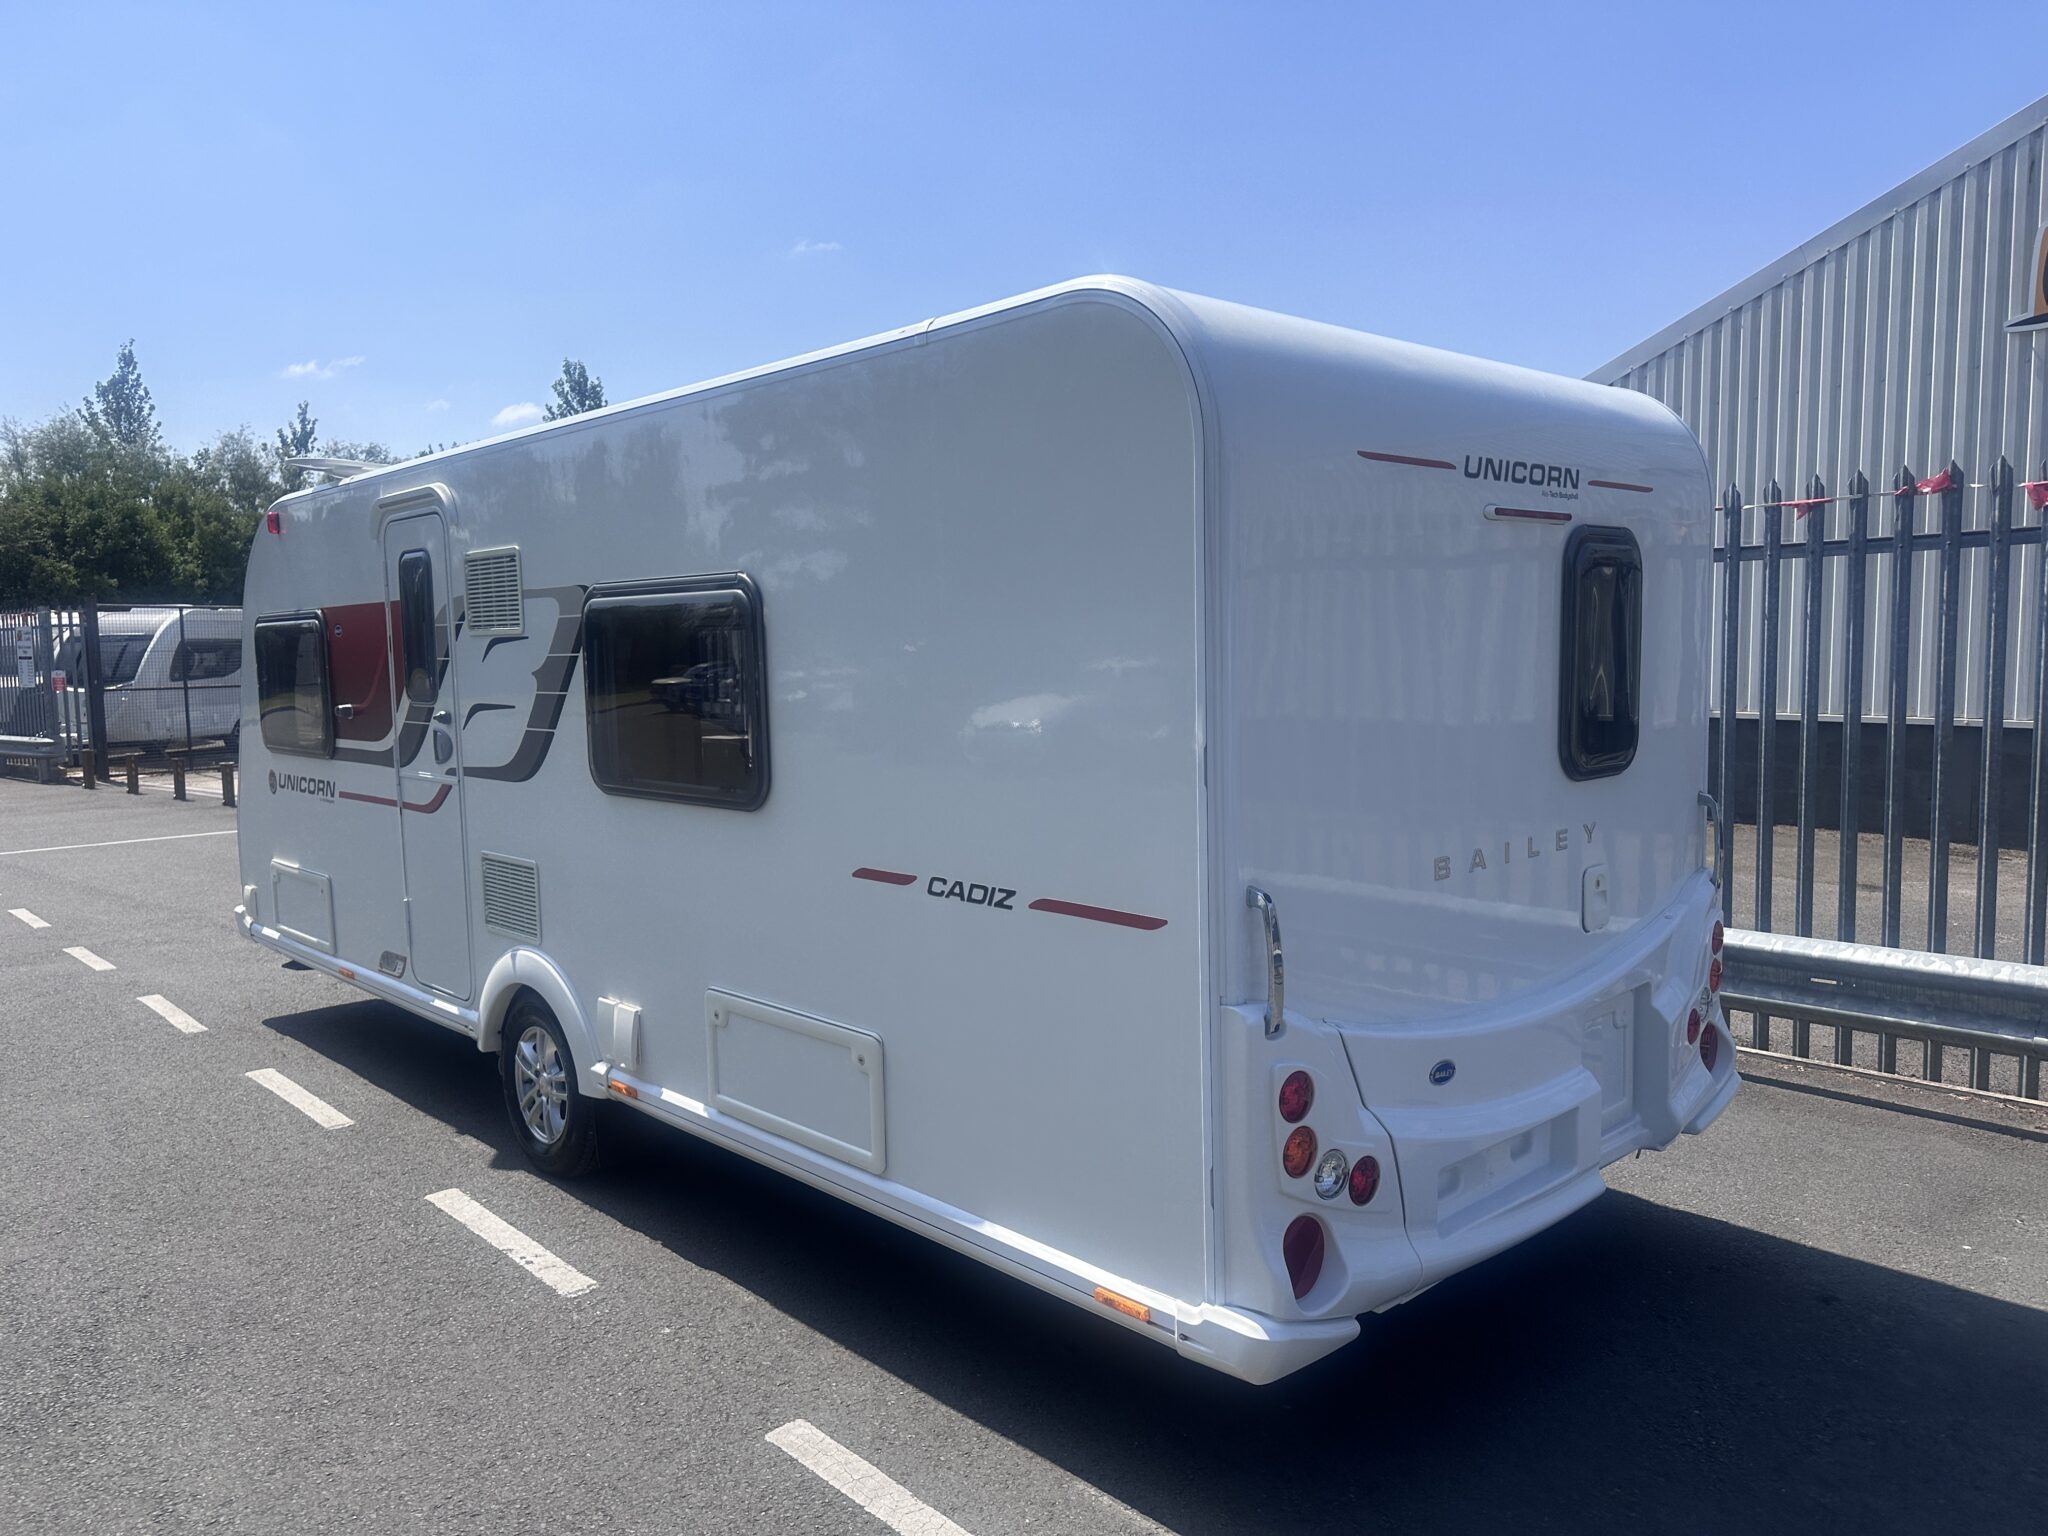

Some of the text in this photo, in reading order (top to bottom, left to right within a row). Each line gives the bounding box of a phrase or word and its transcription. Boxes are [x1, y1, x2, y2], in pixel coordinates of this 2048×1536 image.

[1464, 455, 1580, 489] UNICORN
[278, 773, 335, 798] UNICORN
[1433, 822, 1597, 881] BAILEY
[927, 876, 1016, 910] CADIZ
